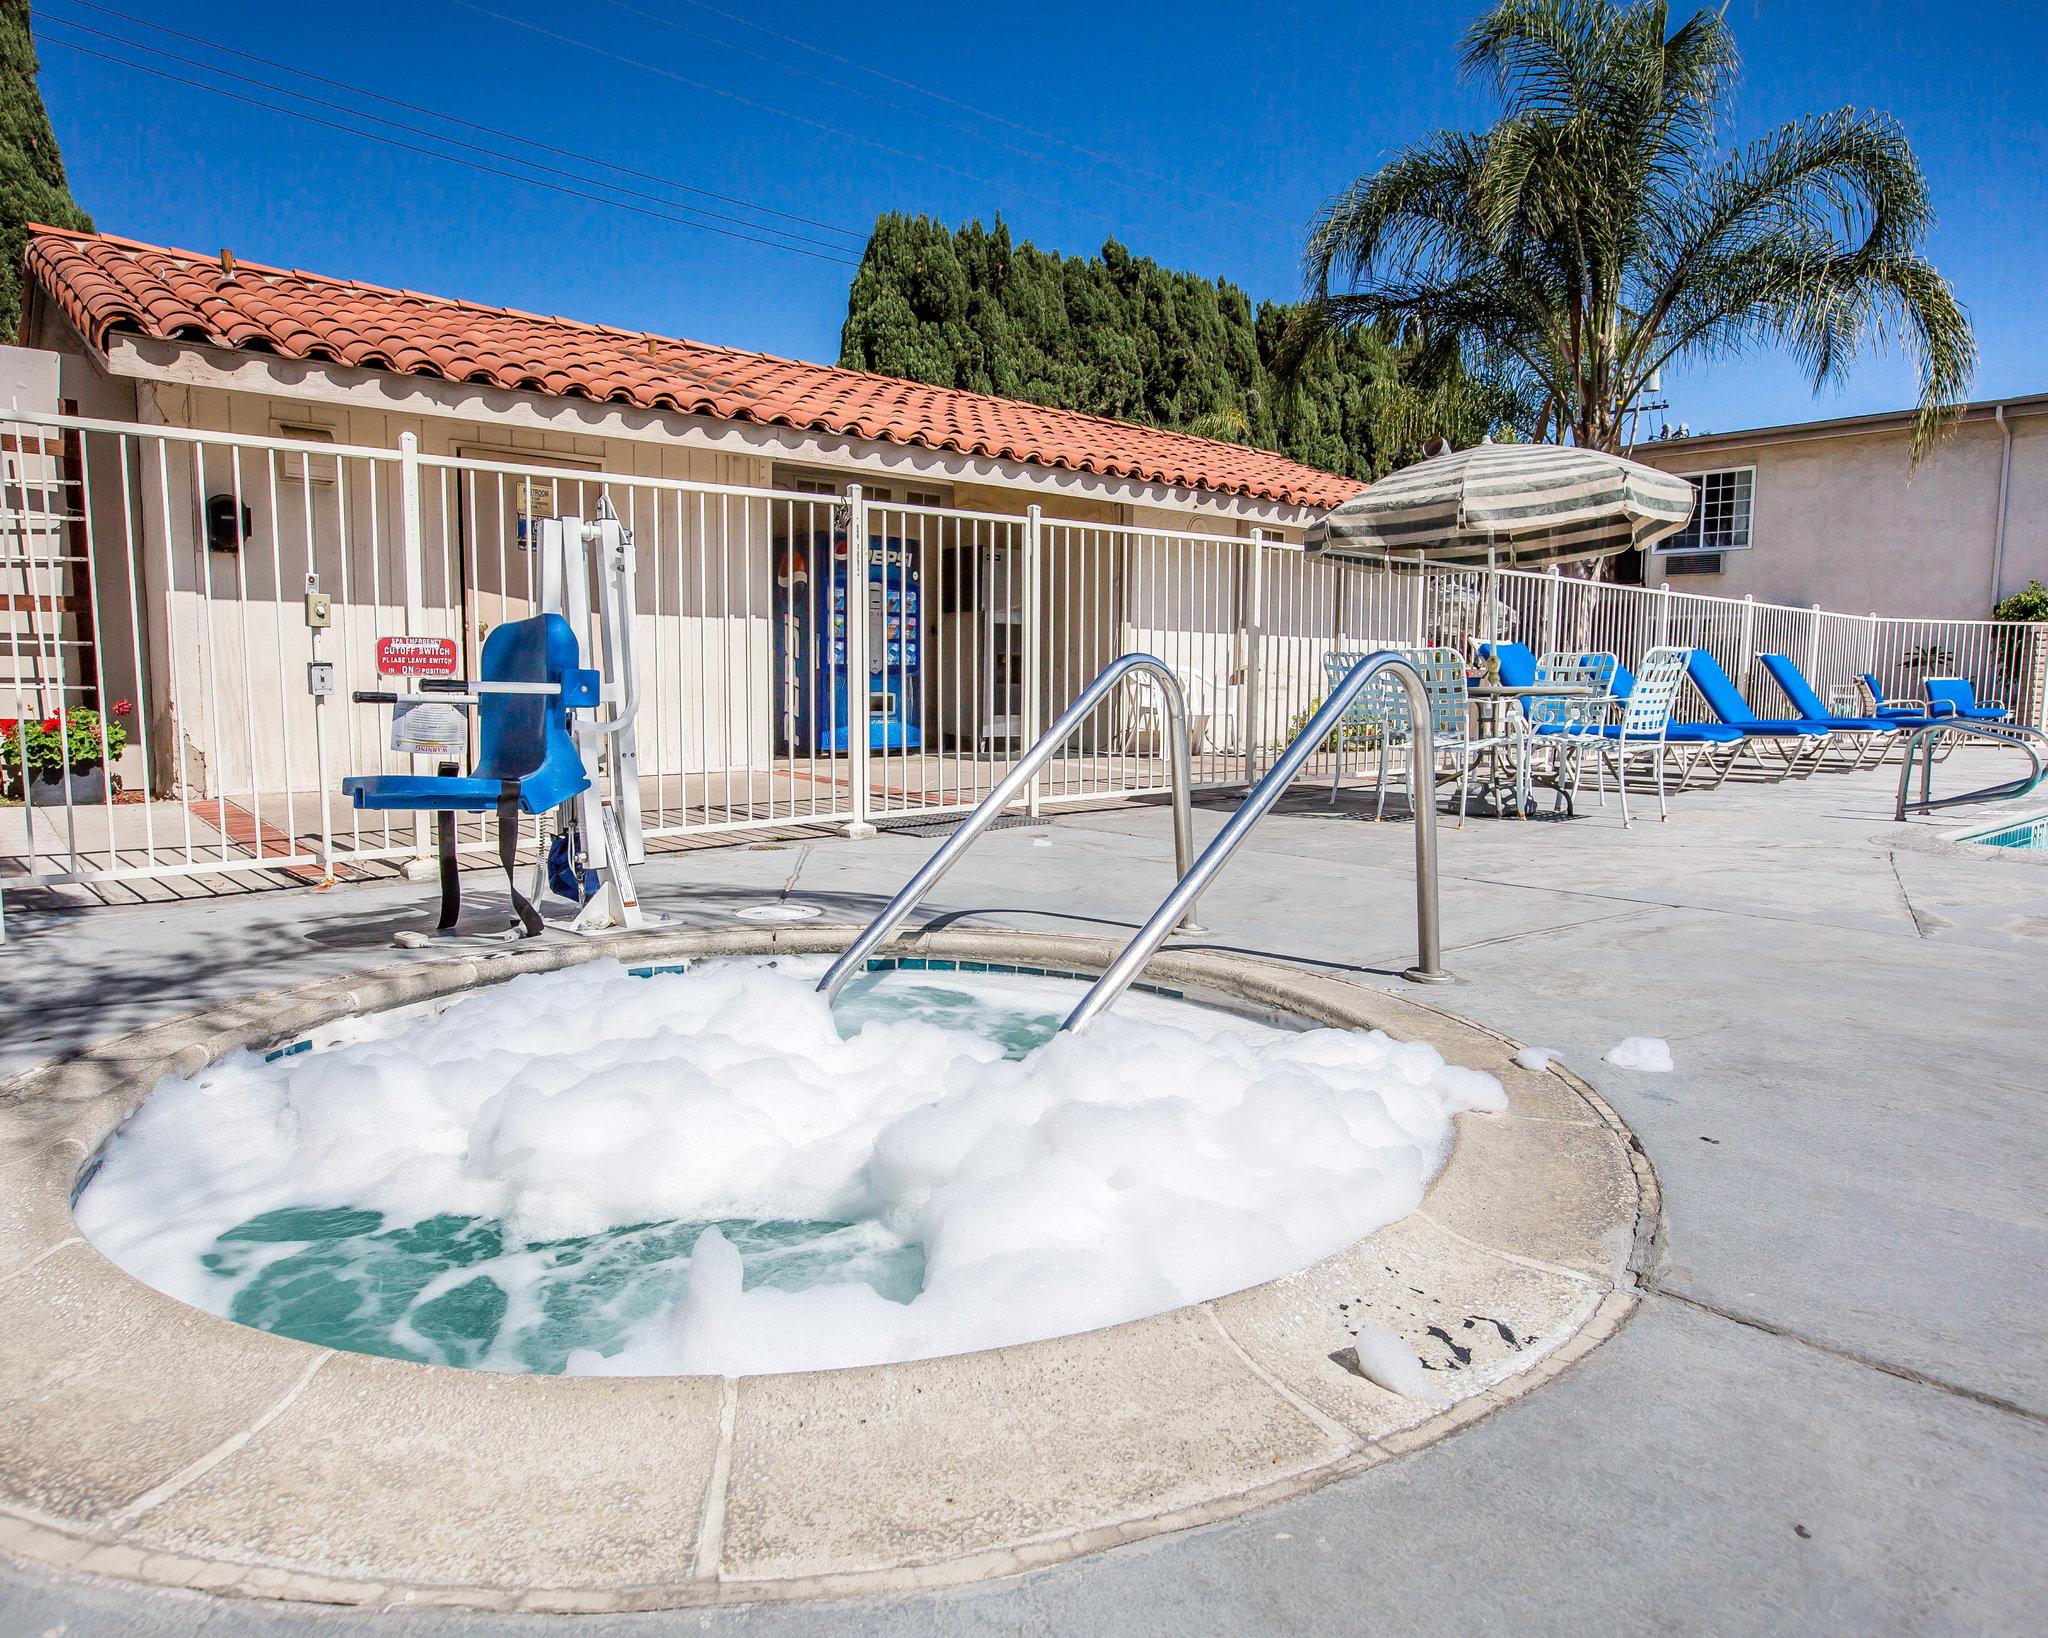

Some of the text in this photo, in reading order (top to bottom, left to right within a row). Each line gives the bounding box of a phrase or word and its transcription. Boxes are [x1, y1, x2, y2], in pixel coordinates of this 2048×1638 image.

[868, 549, 913, 568] EPSI
[384, 646, 450, 656] CUTOFF SWITCH
[402, 665, 414, 675] ON
